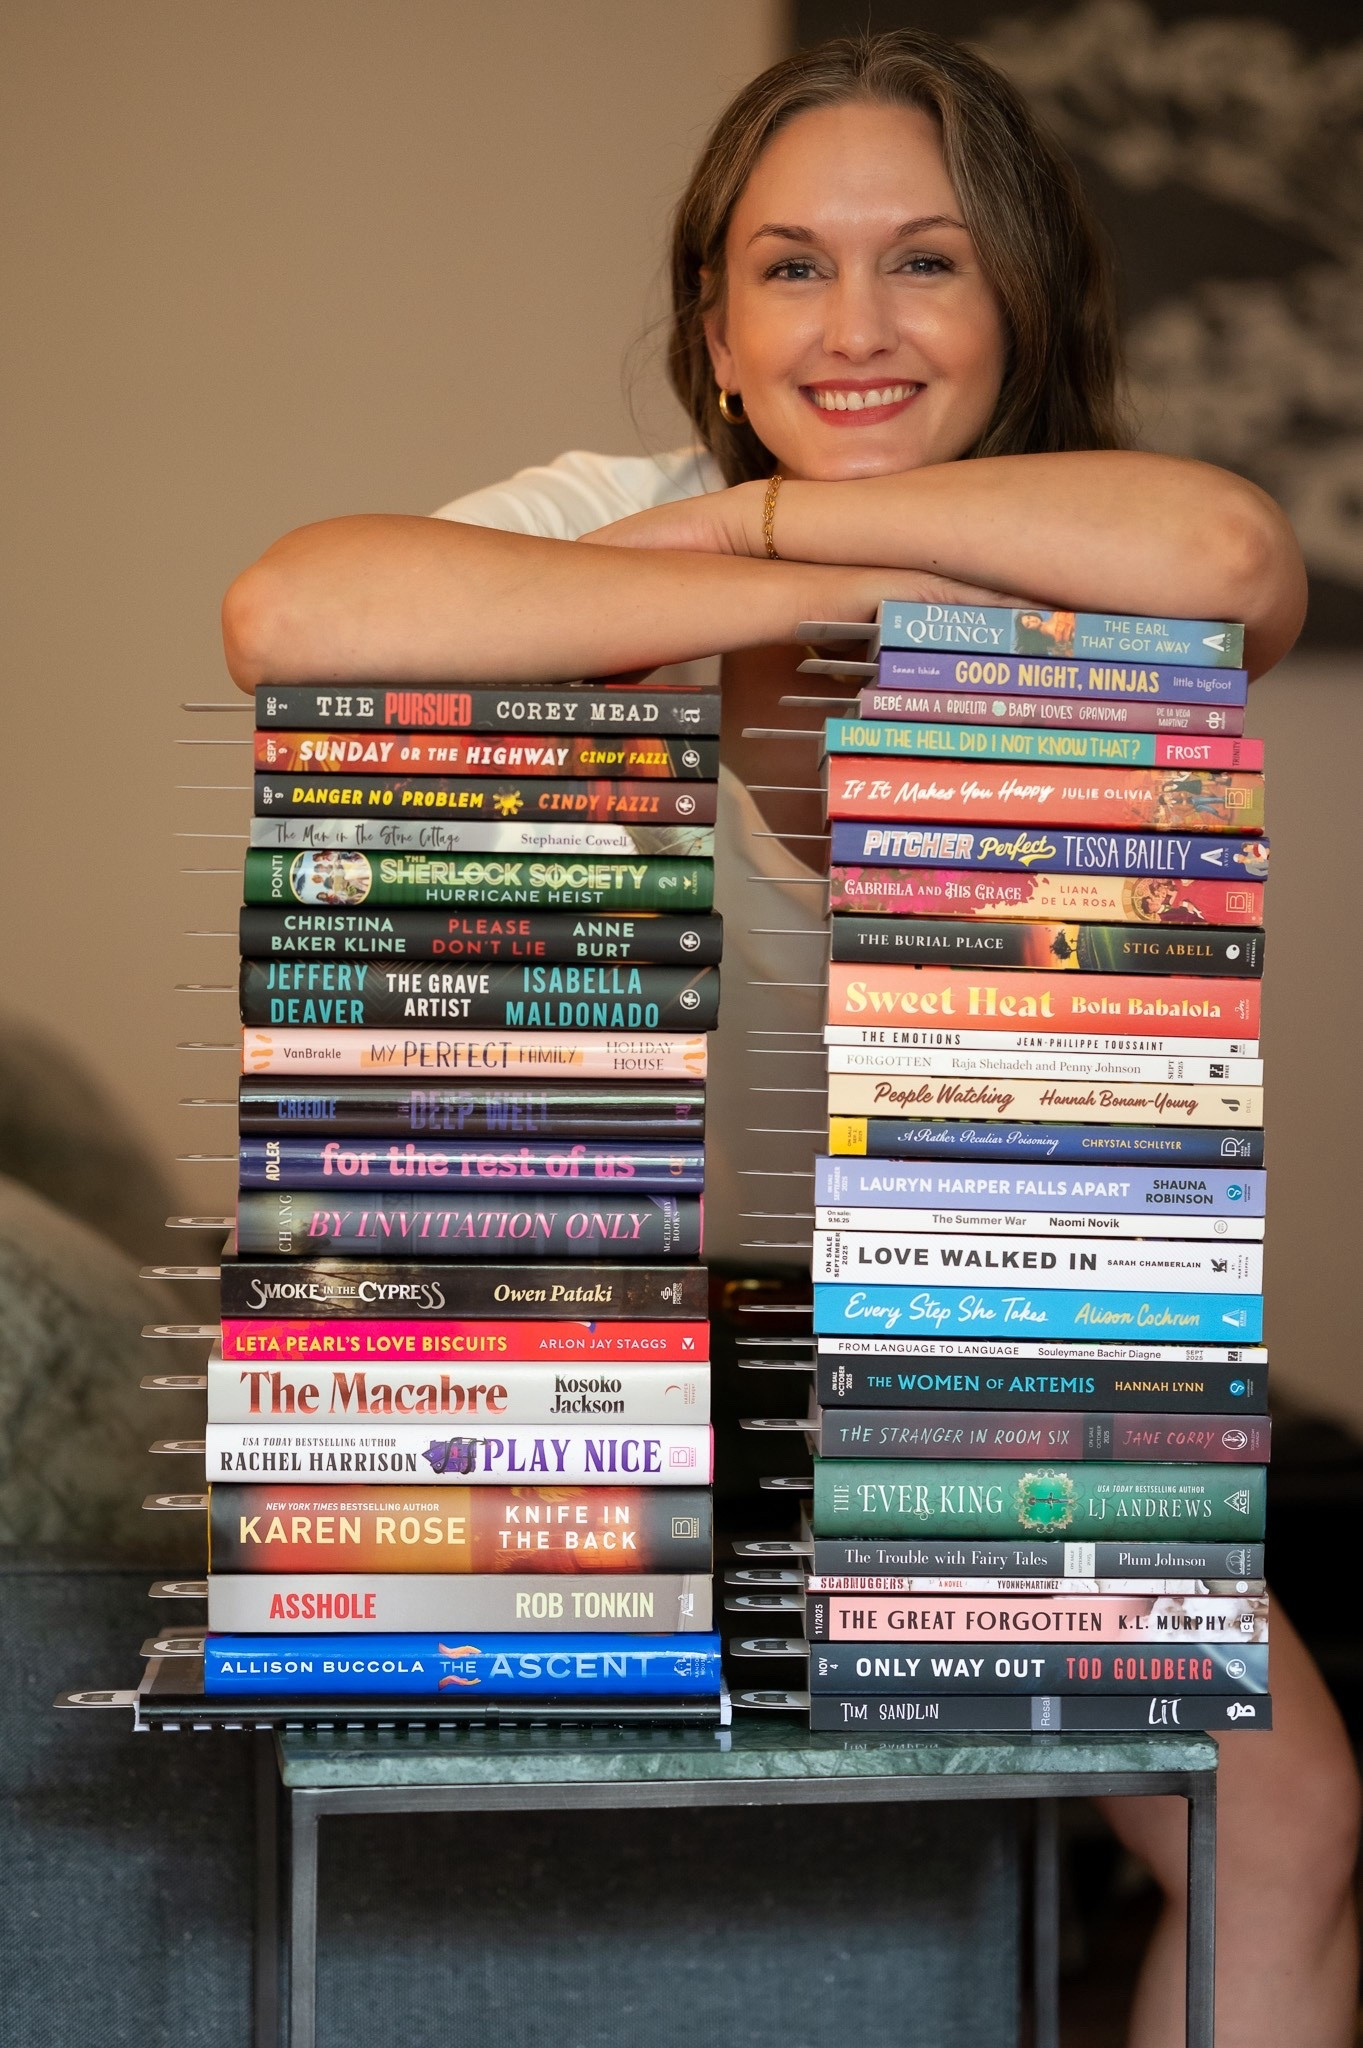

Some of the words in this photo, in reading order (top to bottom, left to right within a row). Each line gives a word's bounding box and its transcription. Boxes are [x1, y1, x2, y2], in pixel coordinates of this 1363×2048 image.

[926, 606, 986, 625] DIANA
[907, 620, 1003, 644] QUINCY
[956, 661, 1010, 685] GOOD
[1019, 665, 1082, 690] NIGHT,
[1089, 669, 1160, 693] NINJAS
[267, 697, 276, 715] DEC
[317, 697, 374, 718] THE
[385, 693, 472, 726] PURSUED
[497, 702, 578, 721] COREY
[590, 704, 659, 722] MEAD
[267, 740, 276, 763] SEPT
[300, 741, 392, 762] SUNDAY
[401, 748, 421, 760] OR
[428, 749, 458, 761] THE
[466, 747, 568, 765] HIGHWAY
[1167, 745, 1211, 759] FROST
[264, 786, 272, 804] SEP
[292, 789, 363, 804] DANGER
[369, 791, 392, 805] NO
[401, 793, 484, 808] PROBLEM
[521, 834, 581, 849] Stephanie
[585, 833, 628, 847] Cowell
[405, 856, 425, 864] THE
[1063, 836, 1120, 868] TESSA
[1126, 838, 1192, 870] BAILEY
[271, 855, 282, 897] PONTI
[381, 859, 521, 886] SHERLOCK
[530, 863, 647, 889] SOCIETY
[659, 876, 676, 888] 2
[426, 890, 541, 903] HURRICANE
[548, 891, 603, 903] HEIST
[1060, 886, 1098, 895] LIANA
[1042, 896, 1057, 905] DE
[1062, 897, 1078, 905] LA
[1083, 897, 1115, 907] ROSA
[285, 916, 393, 932] CHRISTINA
[449, 920, 530, 935] PLEASE
[858, 934, 889, 946] THE
[895, 935, 951, 947] BURIAL
[956, 937, 1004, 949] PLACE
[386, 974, 421, 992] THE
[428, 974, 489, 994] GRAVE
[523, 967, 642, 994] ISABELLA
[404, 998, 471, 1017] ARTIST
[846, 982, 956, 1015] Sweet
[968, 988, 1055, 1017] Heat
[506, 1002, 659, 1027] MALDONADO
[284, 1048, 341, 1059] VanBrakle
[606, 1041, 674, 1054] HOLIDAY
[1017, 1037, 1100, 1049] JEAN-PHILIPPE
[1104, 1039, 1163, 1051] TOUSSAINT
[371, 1044, 397, 1062] MY
[404, 1042, 512, 1068] PERFECT
[519, 1046, 577, 1064] FAMILY
[614, 1057, 664, 1071] HOUSE
[875, 1083, 932, 1104] People
[938, 1084, 1014, 1112] Watching
[1082, 1139, 1130, 1149] CHRYSTAL
[1134, 1140, 1181, 1150] SCHLEYER
[266, 1141, 279, 1181] ADLER
[1153, 1180, 1207, 1190] SHAUNA
[1145, 1192, 1213, 1204] ROBINSON
[279, 1195, 292, 1252] CHANG
[308, 1211, 351, 1237] BY
[357, 1212, 557, 1239] INVITATION
[566, 1213, 651, 1239] ONLY
[932, 1214, 952, 1224] The
[954, 1215, 1003, 1225] Summer
[1006, 1216, 1026, 1226] War
[1049, 1217, 1085, 1228] Naomi
[1088, 1217, 1119, 1228] Novik
[859, 1247, 929, 1266] LOVE
[941, 1250, 1058, 1269] WALKED
[1069, 1254, 1097, 1270] IN
[1107, 1259, 1136, 1267] SARAH
[1139, 1260, 1201, 1268] CHAMBERLAIN
[494, 1284, 546, 1302] Owen
[550, 1284, 612, 1302] Pataki
[1075, 1307, 1134, 1325] Alison
[1137, 1307, 1199, 1327] Cochrun
[539, 1339, 584, 1349] ARLON
[588, 1339, 610, 1349] JAY
[616, 1339, 667, 1349] STAGGS
[838, 1343, 869, 1352] FROM
[873, 1344, 936, 1354] LANGUAGE
[940, 1345, 955, 1354] TO
[958, 1346, 1019, 1355] LANGUAGE
[240, 1372, 319, 1413] The
[330, 1373, 508, 1413] Macabre
[1115, 1381, 1168, 1391] HANNAH
[1172, 1382, 1204, 1392] LYNN
[242, 1438, 260, 1446] USA
[263, 1438, 292, 1446] TODAY
[296, 1438, 355, 1446] BESTSELLING
[358, 1438, 396, 1447] AUTHOR
[221, 1452, 301, 1472] RACHEL
[309, 1452, 417, 1473] HARRISON
[483, 1438, 570, 1473] PLAY
[585, 1440, 662, 1473] NICE
[1097, 1485, 1110, 1493] USA
[1113, 1485, 1133, 1493] TODAY
[1135, 1485, 1180, 1494] BESTSELLING
[1184, 1486, 1205, 1494] AUTHOR
[266, 1503, 285, 1511] NEW
[288, 1503, 310, 1511] YORK
[313, 1503, 338, 1511] TIMES
[340, 1503, 400, 1511] BESTSELLING
[403, 1503, 439, 1511] AUTHOR
[1240, 1490, 1249, 1514] ACE
[240, 1516, 361, 1544] KAREN
[376, 1517, 465, 1545] ROSE
[821, 1578, 903, 1589] SCABMUGGERS
[998, 1580, 1022, 1589] YVONNE
[1025, 1580, 1059, 1589] MARTINEZ
[270, 1594, 376, 1619] ASSHOLE
[815, 1604, 823, 1634] 11/2025
[840, 1611, 877, 1629] THE
[888, 1611, 954, 1630] GREAT
[966, 1612, 1102, 1631] FORGOTTEN
[819, 1657, 827, 1676] NOV
[856, 1659, 920, 1677] ONLY
[931, 1659, 985, 1677] WAY
[995, 1659, 1045, 1678] OUT
[840, 1703, 867, 1721] TIM
[879, 1704, 938, 1720] SANDLIN
